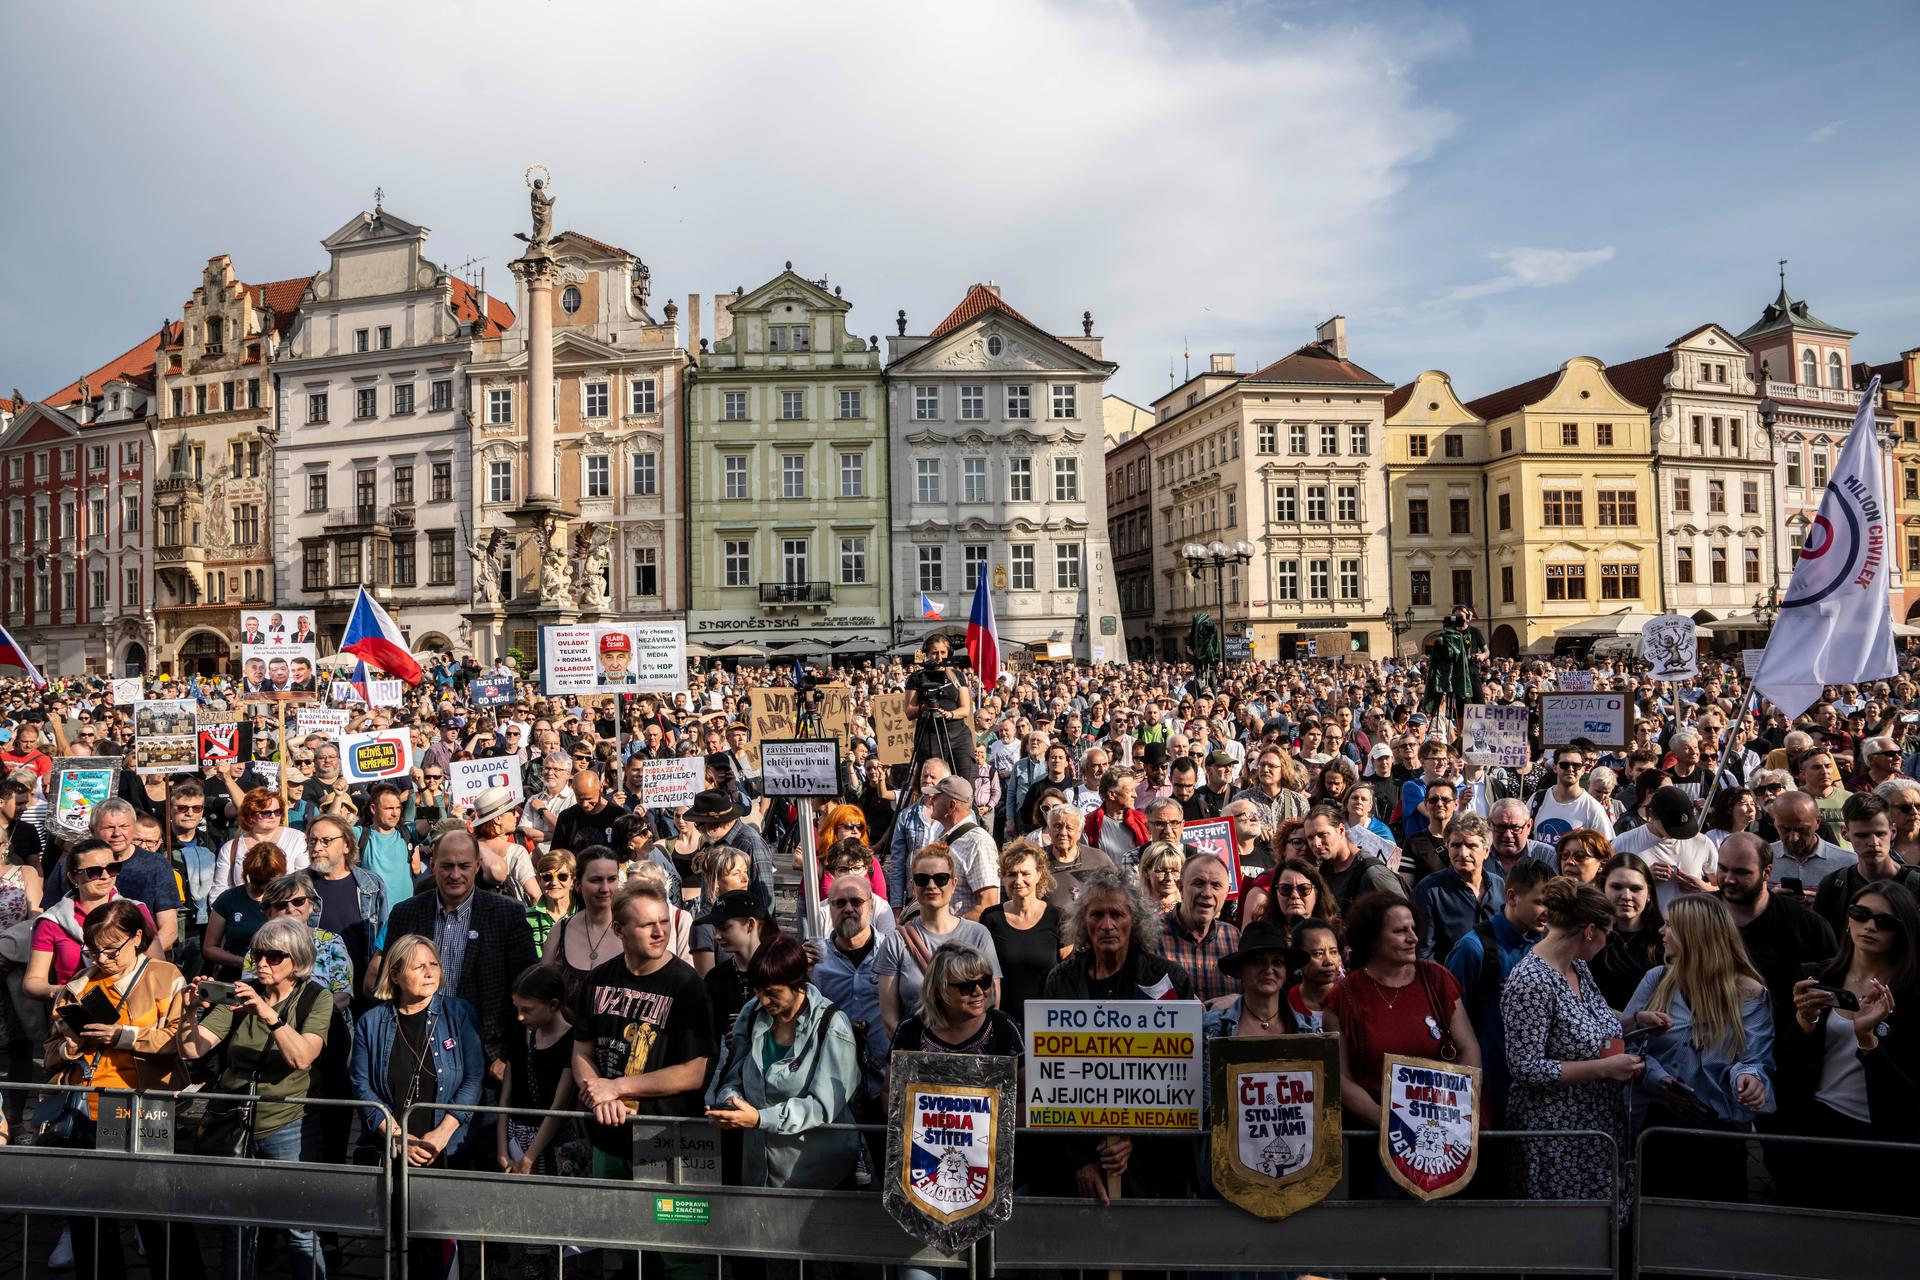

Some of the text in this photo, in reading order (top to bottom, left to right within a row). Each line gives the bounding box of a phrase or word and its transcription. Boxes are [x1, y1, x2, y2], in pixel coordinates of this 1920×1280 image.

[1843, 474, 1881, 522] MILION
[1854, 525, 1884, 590] CHVILEK
[1095, 551, 1104, 607] HOTEL
[1546, 566, 1584, 576] CAFE
[1601, 565, 1638, 575] CAFE
[698, 615, 799, 630] STAROMĚSTSKÁ
[605, 634, 624, 642] SLABÉ
[478, 696, 489, 704] OD
[197, 724, 217, 732] RUCE
[382, 745, 394, 755] TAK
[461, 760, 509, 774] OVLADAČ
[794, 757, 829, 766] ovlivnit
[466, 780, 482, 789] OD
[652, 771, 697, 781] ROZHLEDEM
[772, 774, 830, 792] volby...
[652, 791, 697, 803] CENZURO
[1182, 823, 1227, 840] RUCE PRYČ
[1047, 1005, 1179, 1028] PRO ČRo a ČT
[1033, 1036, 1135, 1054] POPLATKY
[1152, 1037, 1195, 1055] ANO
[1040, 1061, 1065, 1080] NE
[1031, 1084, 1195, 1105] A JEJICH PIKOLÍKY
[1240, 1076, 1268, 1106] ČT
[1276, 1075, 1314, 1105] ČRo
[918, 1095, 991, 1113] SVOBODNÁ
[922, 1110, 974, 1130] MÉDIA
[1030, 1107, 1199, 1126] MÉDIA VLÁDĚ NEDÁME
[1245, 1105, 1303, 1122] STOJÍME
[923, 1127, 973, 1147] ŠTÍTEM
[1248, 1120, 1306, 1138] ZA VÁMI
[1389, 1130, 1471, 1175] DEMOKRACIE
[911, 1168, 987, 1203] DEMOKRACIE
